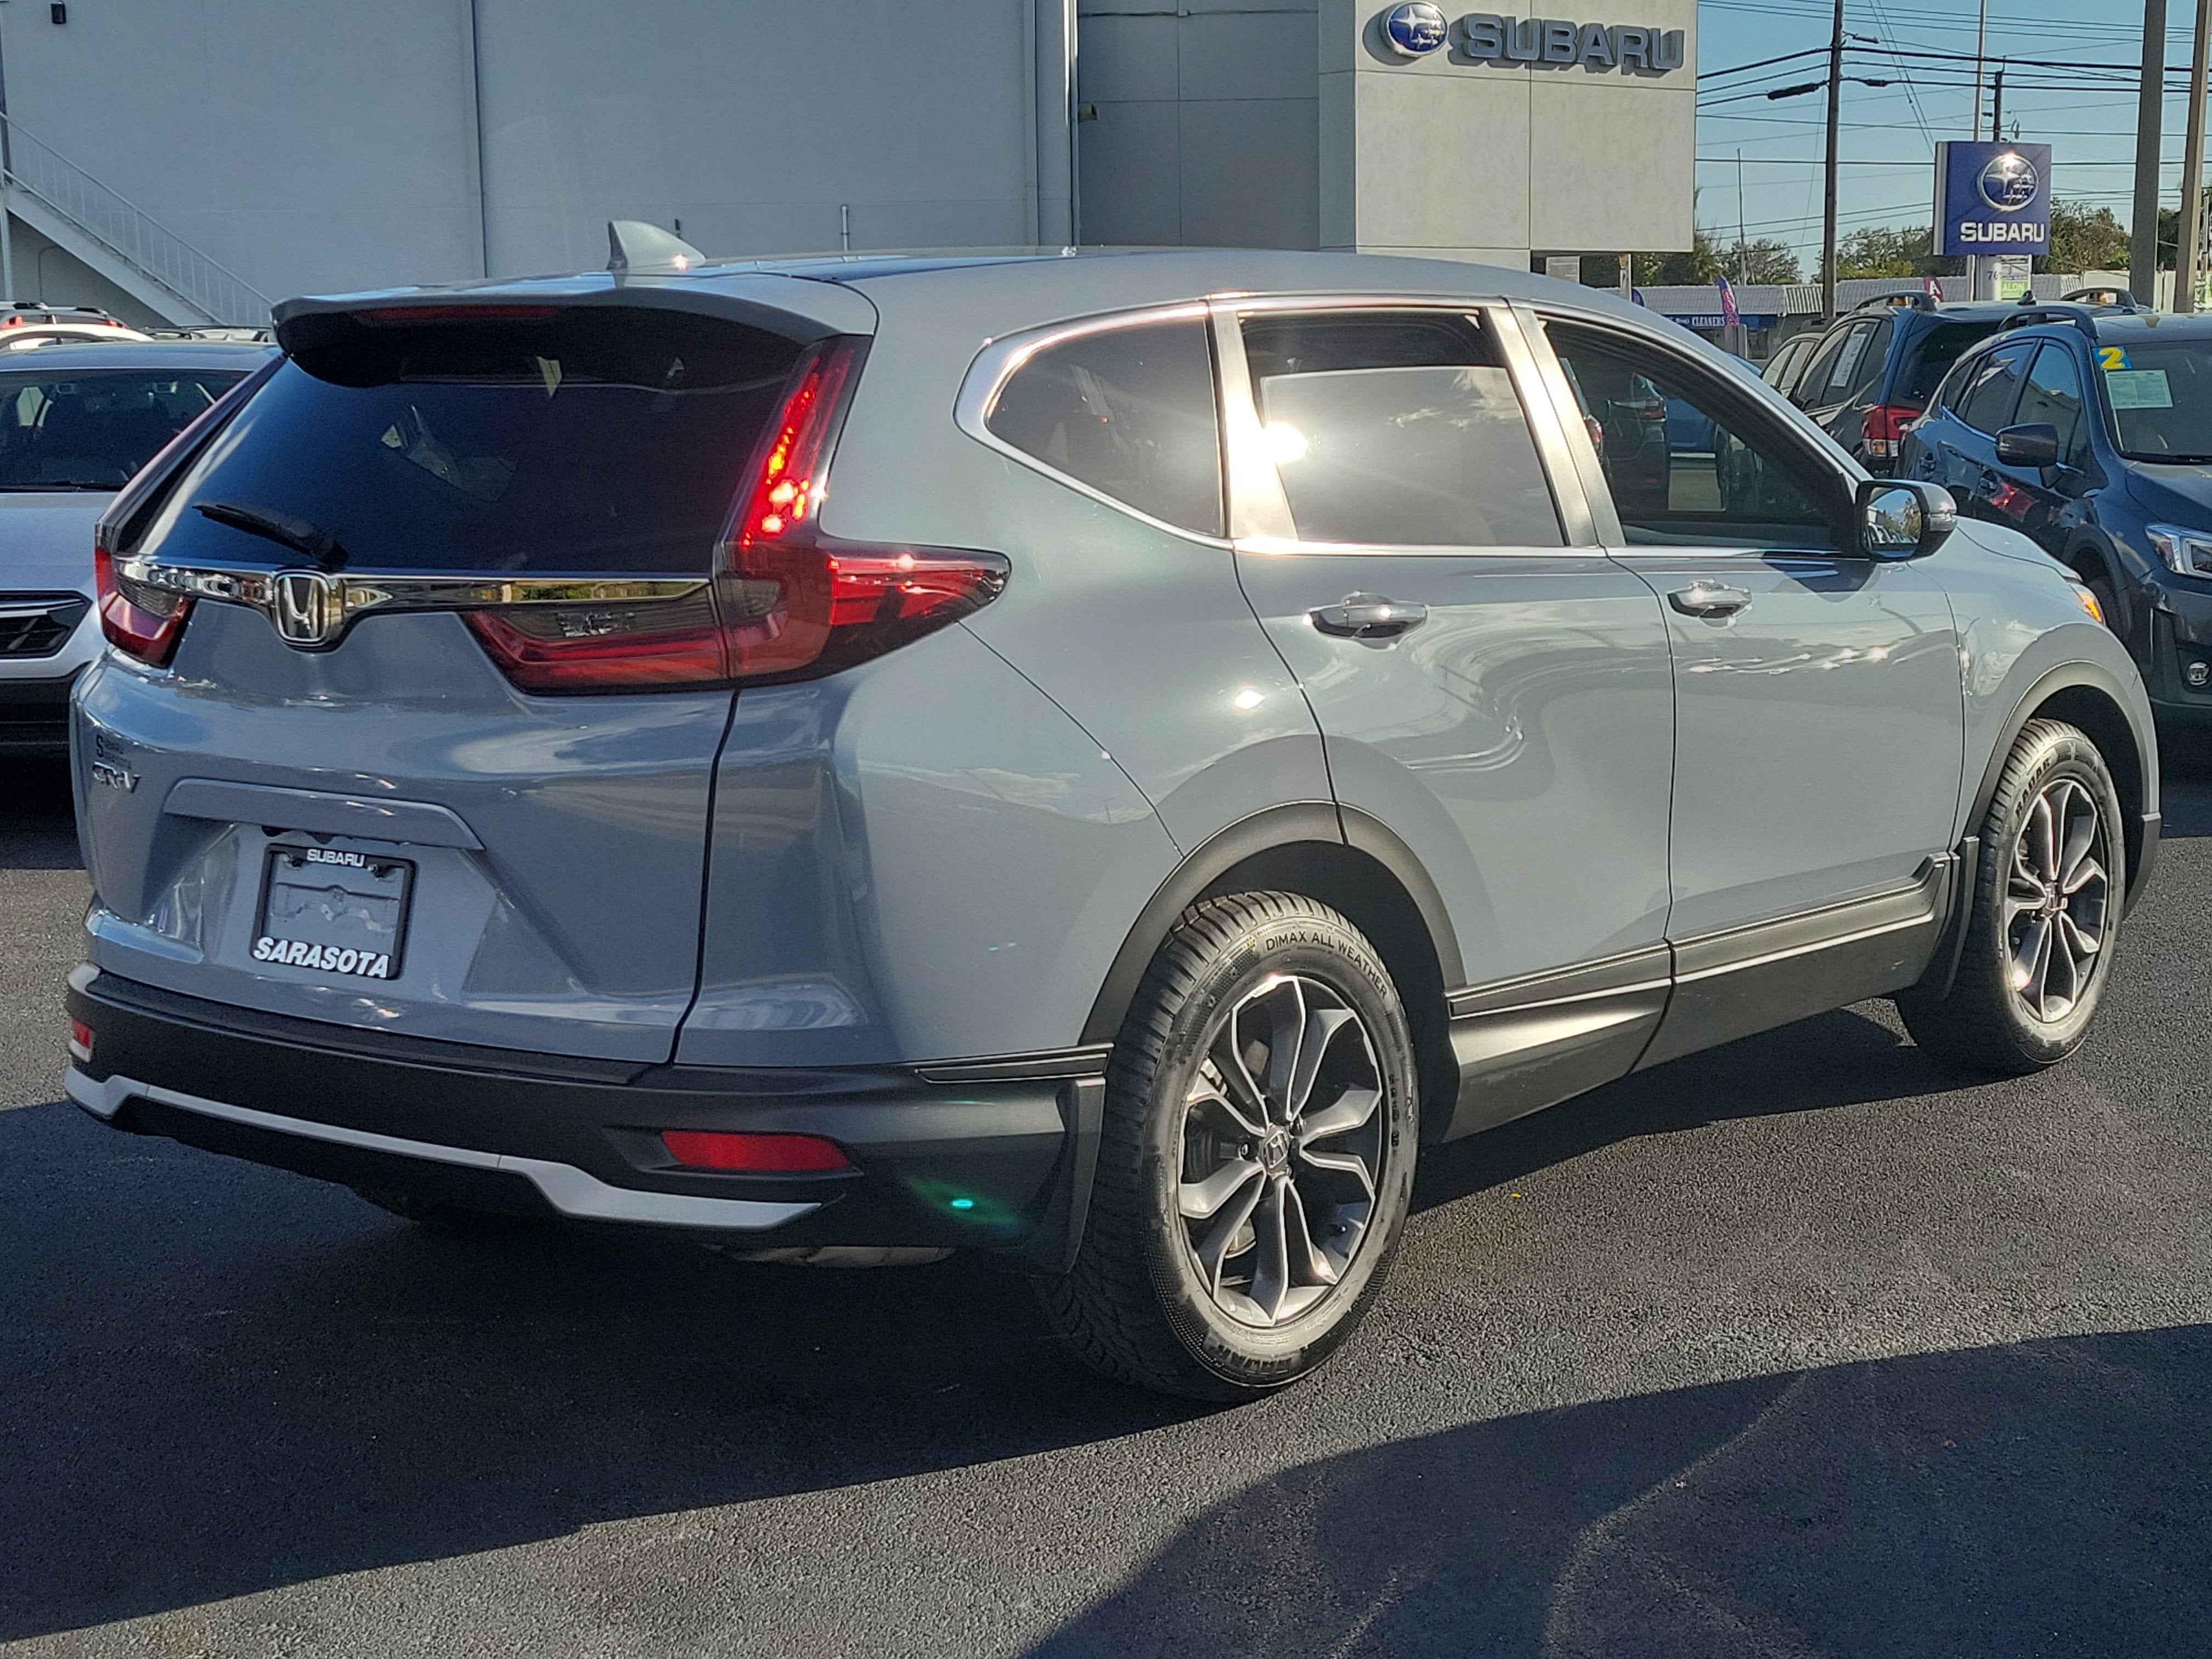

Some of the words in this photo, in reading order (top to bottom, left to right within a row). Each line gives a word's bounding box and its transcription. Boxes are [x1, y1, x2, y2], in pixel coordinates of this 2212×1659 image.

[1465, 13, 1685, 70] SUBARU
[1960, 222, 2045, 242] SUBARU
[1691, 315, 1726, 328] CLEANERS
[2098, 347, 2125, 369] 2
[307, 849, 365, 867] SUBARU
[253, 936, 390, 978] SARASOTA
[1266, 930, 1307, 951] DIMAX
[1311, 931, 1335, 949] ALL
[1338, 939, 1387, 1000] WEATHER
